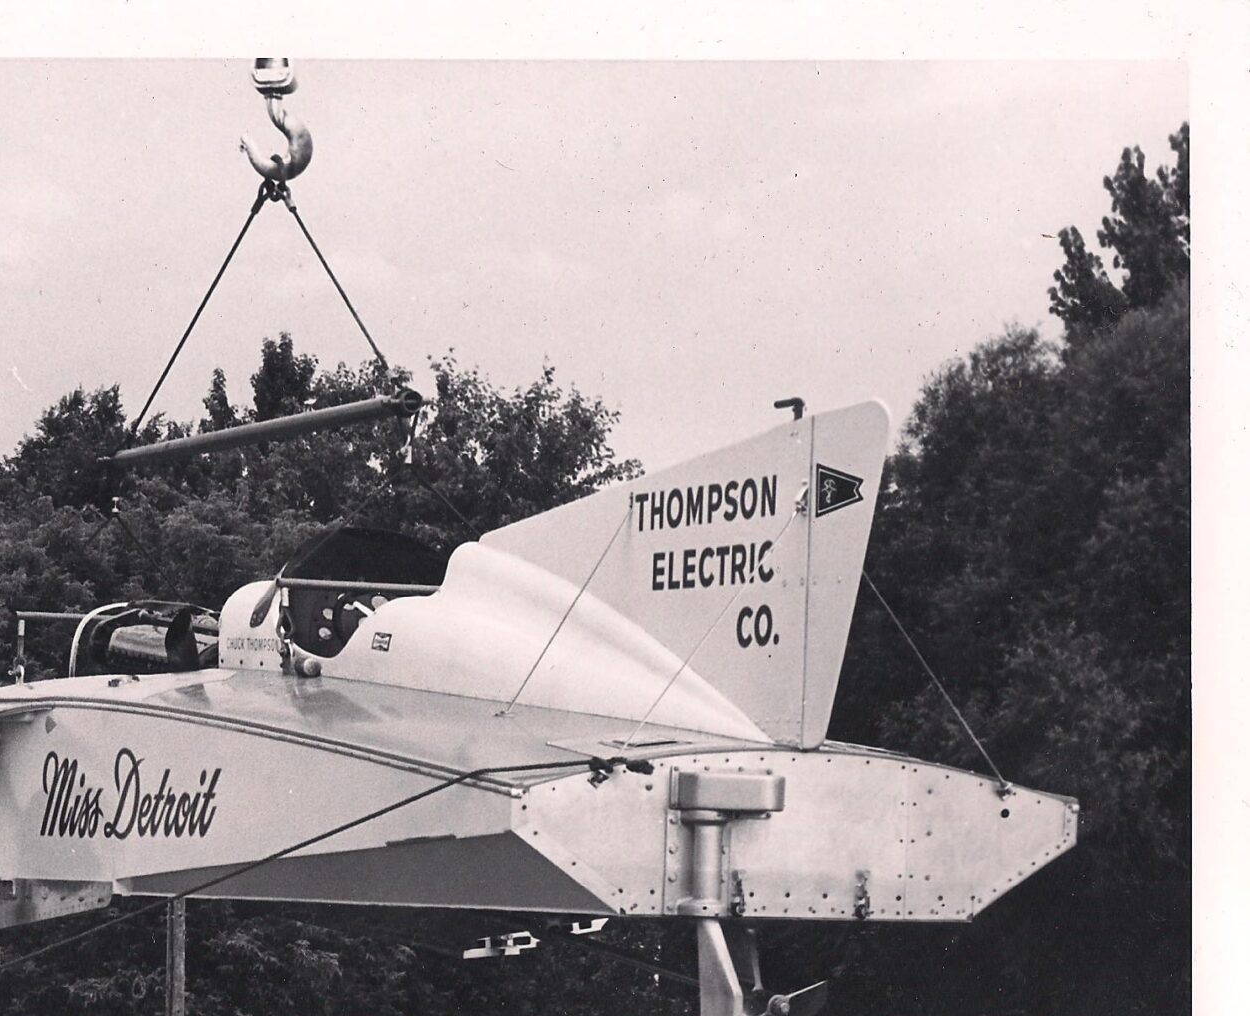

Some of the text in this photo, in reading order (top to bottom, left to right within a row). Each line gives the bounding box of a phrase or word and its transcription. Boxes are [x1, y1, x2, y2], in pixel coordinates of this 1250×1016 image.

[635, 474, 778, 532] THOMPSON
[652, 540, 775, 591] ELECTRIC
[736, 604, 780, 648] CO.
[40, 747, 223, 840] Miss Detroit
